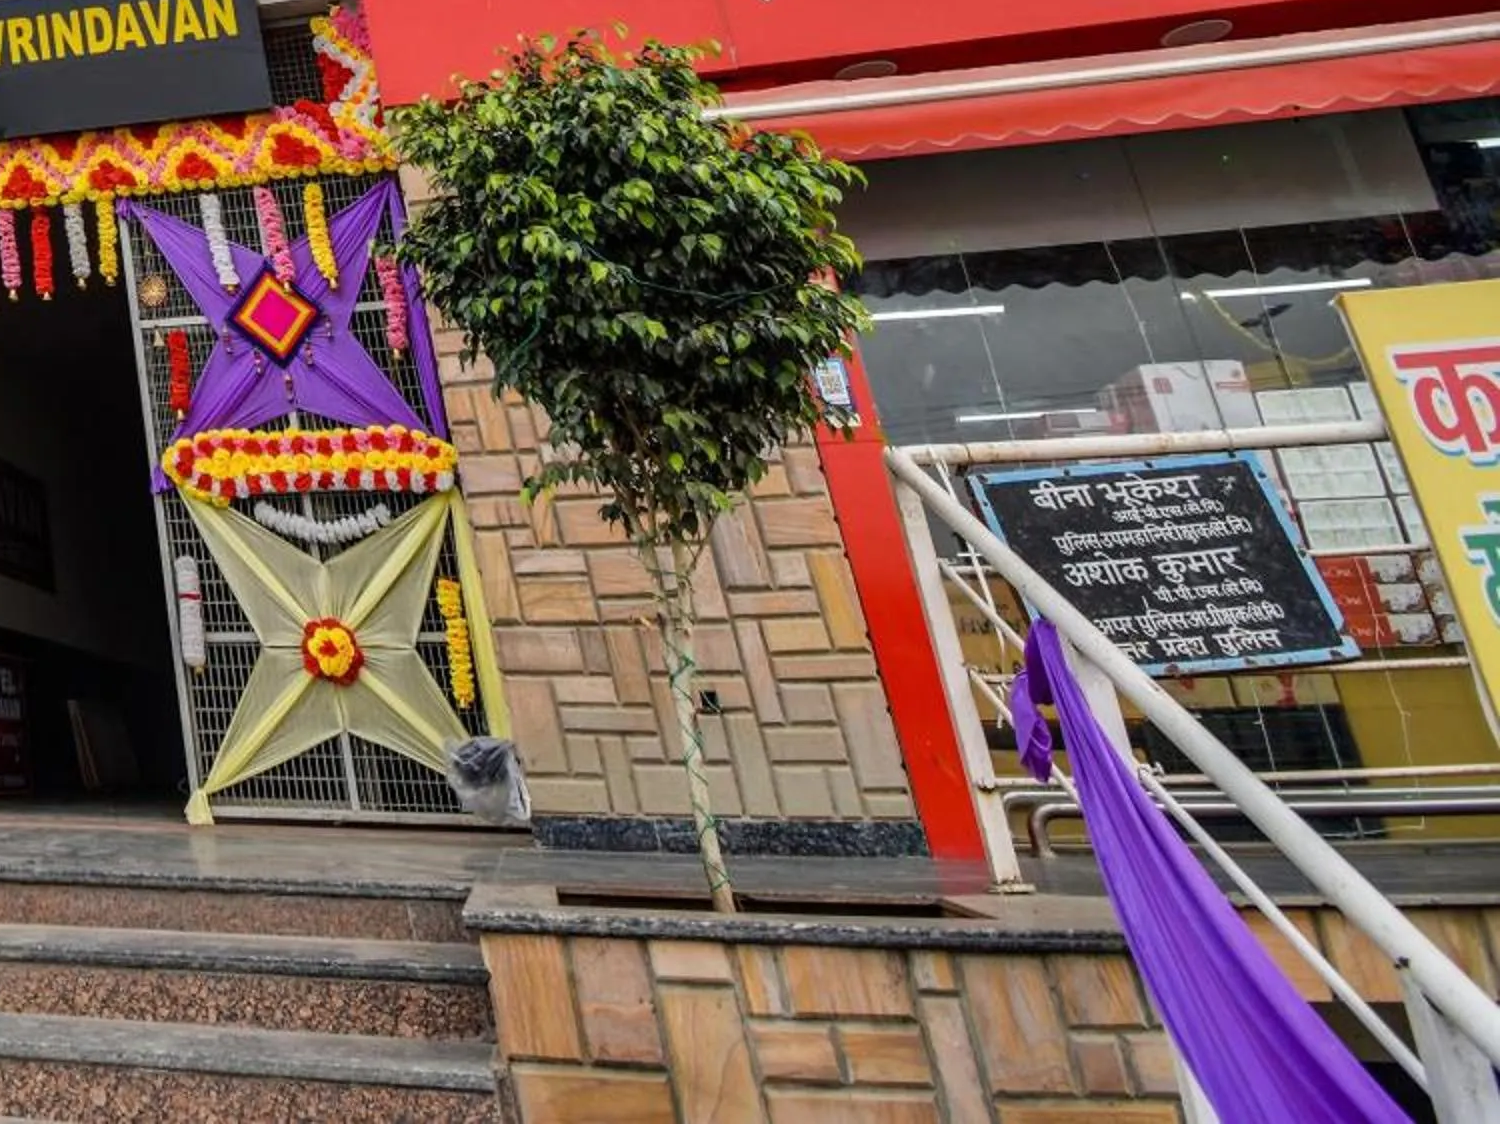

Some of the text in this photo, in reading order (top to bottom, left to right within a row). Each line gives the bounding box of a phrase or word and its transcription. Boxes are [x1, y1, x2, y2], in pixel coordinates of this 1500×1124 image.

[1029, 479, 1094, 510] बीना
[1062, 545, 1248, 588] अशोक कुमार
[1156, 632, 1210, 658] प्रदेश
[1212, 626, 1283, 656] पुलिस
